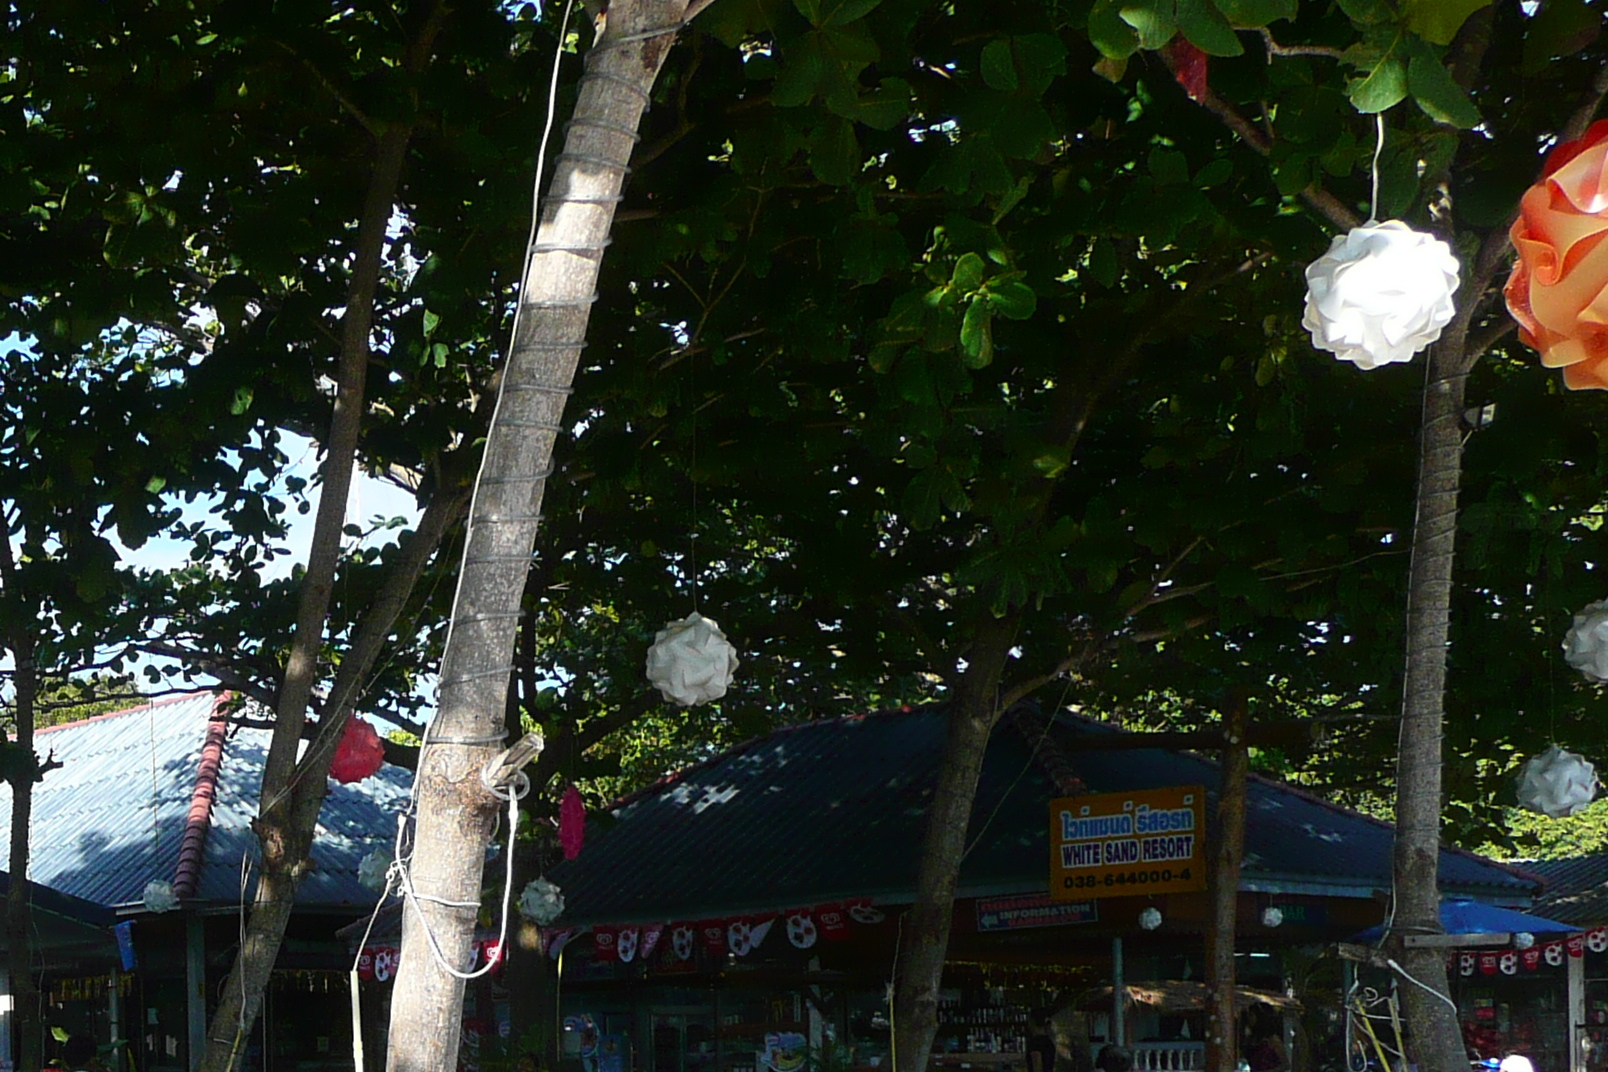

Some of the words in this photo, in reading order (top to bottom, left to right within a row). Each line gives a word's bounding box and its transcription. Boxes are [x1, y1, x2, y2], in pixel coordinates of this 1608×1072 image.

[1061, 843, 1102, 868] WHITE
[1104, 839, 1140, 864] SAND
[1141, 835, 1194, 862] RESORT
[1064, 869, 1191, 889] 038-644000-4
[999, 904, 1091, 920] INFORMATION
